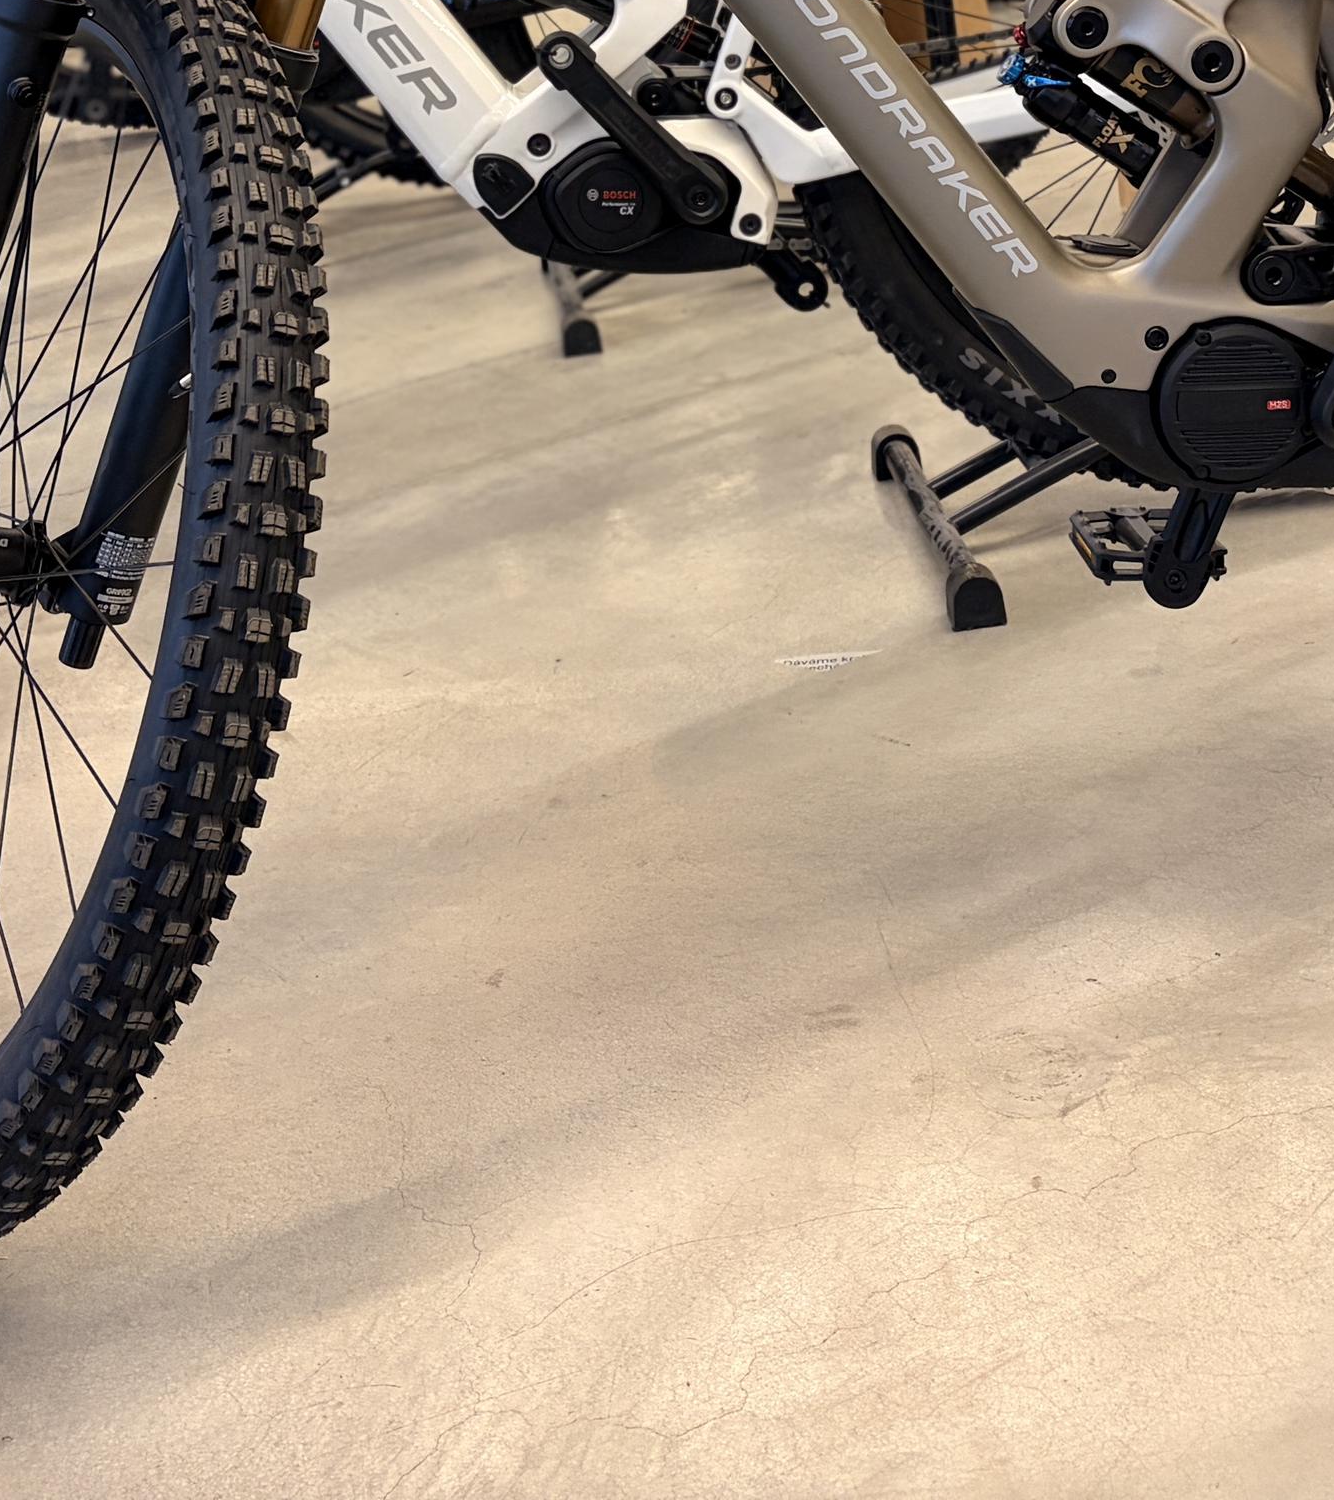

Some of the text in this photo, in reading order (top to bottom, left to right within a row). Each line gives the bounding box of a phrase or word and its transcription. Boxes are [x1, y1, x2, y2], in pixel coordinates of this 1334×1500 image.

[1107, 125, 1135, 154] X
[602, 191, 636, 200] BOSCH
[619, 206, 634, 216] CX
[1269, 400, 1289, 410] M2S
